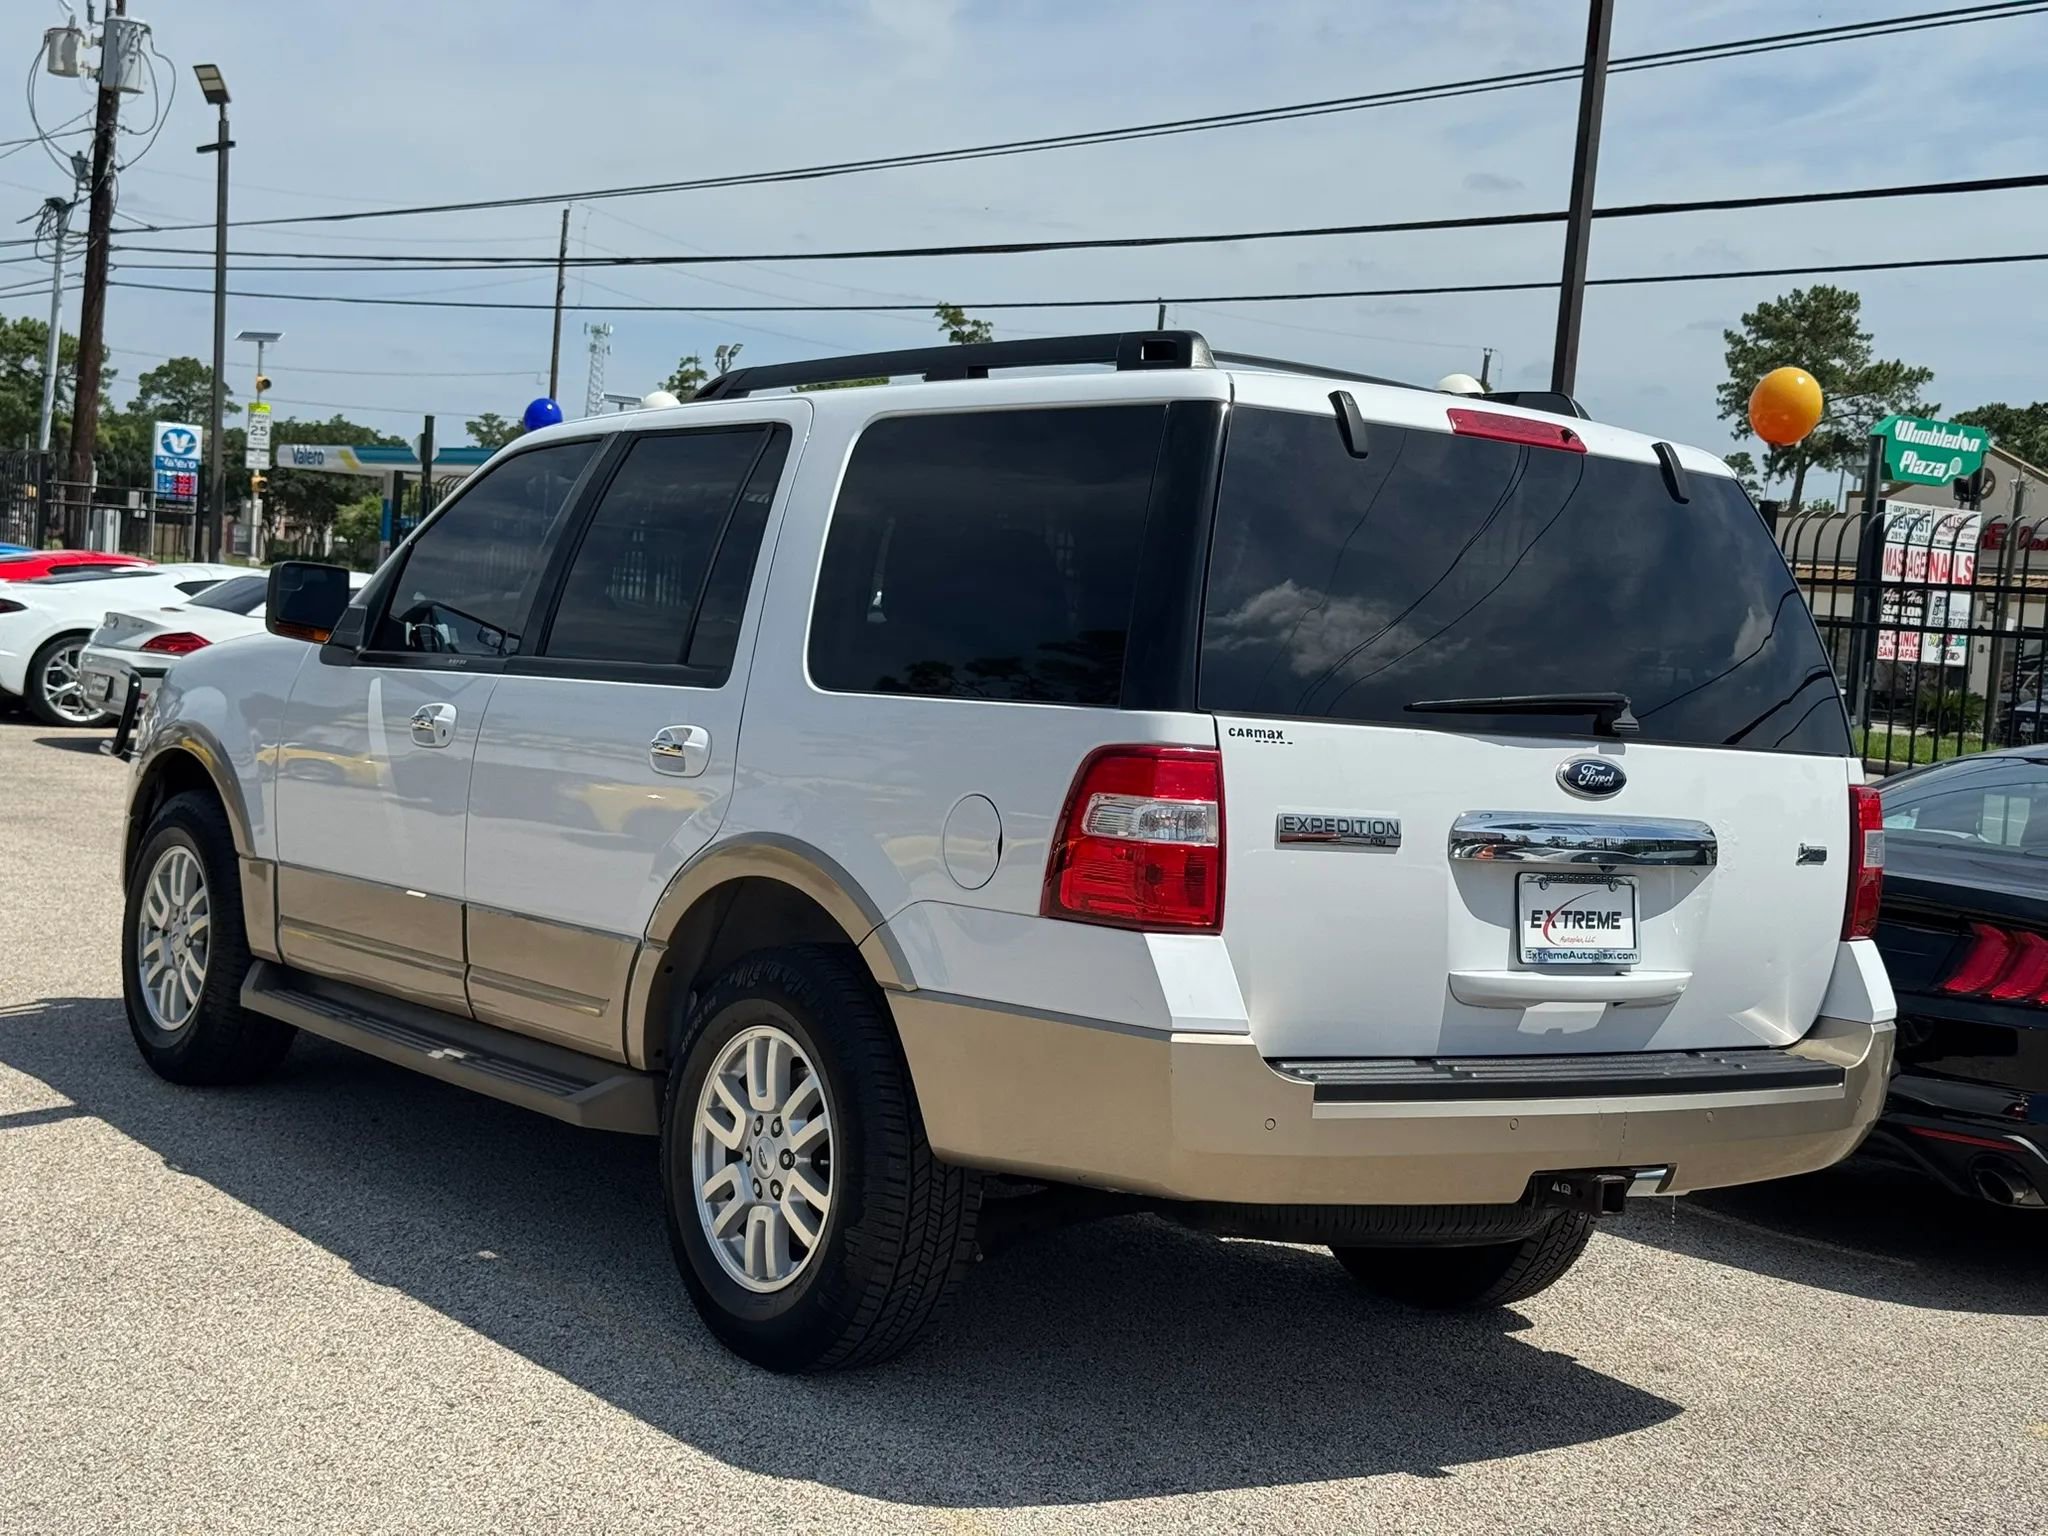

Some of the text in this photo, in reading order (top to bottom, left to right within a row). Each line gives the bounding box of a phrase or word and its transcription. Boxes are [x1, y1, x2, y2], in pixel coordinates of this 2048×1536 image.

[250, 426, 269, 437] 25
[1895, 420, 1981, 452] Wimbledon
[292, 445, 325, 465] Valero
[1899, 450, 1948, 477] Plaza
[1884, 547, 1926, 579] MASAGE
[1929, 552, 1973, 585] NALS
[1882, 604, 1923, 618] SALON
[1878, 647, 1920, 659] SAN AFAE
[1577, 764, 1615, 787] Ford
[1283, 816, 1400, 836] EXPEDITION
[1530, 909, 1622, 930] EXTREME
[1525, 950, 1638, 962] ExtremeAutoplex.com
